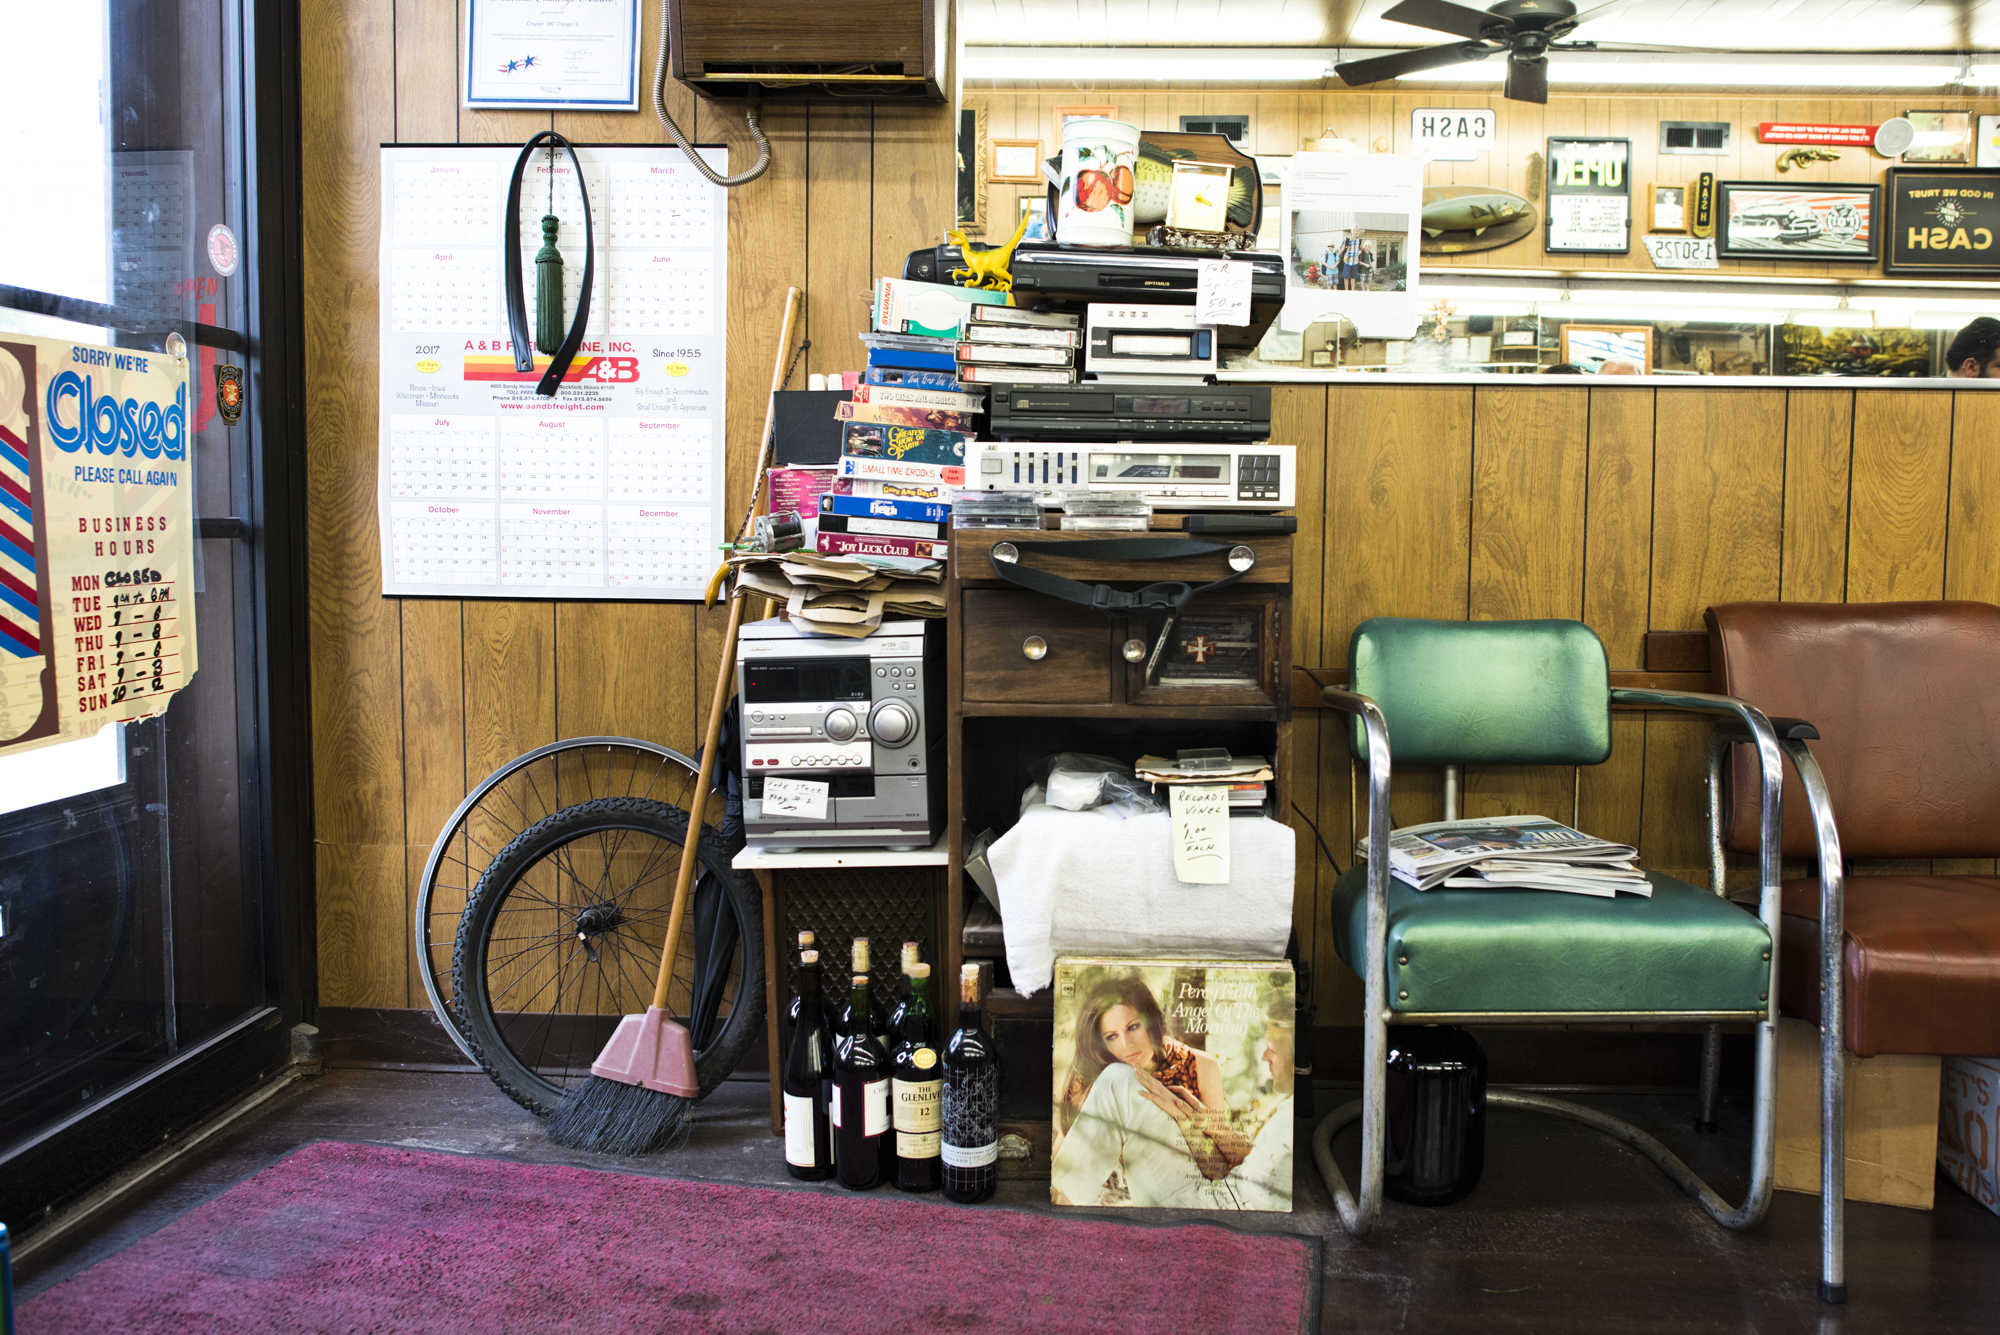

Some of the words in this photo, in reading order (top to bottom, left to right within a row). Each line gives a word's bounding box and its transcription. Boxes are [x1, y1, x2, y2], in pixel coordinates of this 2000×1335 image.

[430, 166, 461, 176] January
[650, 166, 675, 175] March
[434, 252, 453, 262] April
[651, 254, 671, 263] June
[881, 282, 892, 326] SYLVANIA
[415, 345, 440, 355] 2017
[652, 348, 675, 358] Since
[676, 348, 702, 358] 1955
[464, 340, 475, 351] A
[478, 340, 487, 351] &
[492, 340, 502, 351] B
[608, 342, 635, 353] INC.
[72, 346, 112, 368] SORRY
[114, 353, 149, 373] WE'RE
[578, 356, 641, 384] A&B
[415, 399, 440, 407] Missouri
[500, 402, 605, 412] www.aandbfreight.com
[46, 370, 187, 462] Closed
[434, 418, 451, 428] July
[538, 420, 566, 429] August
[638, 421, 681, 431] September
[888, 426, 926, 442] GREATEST
[915, 432, 925, 441] ON
[74, 465, 115, 484] PLEASE
[118, 468, 144, 485] CALL
[145, 470, 178, 487] AGAIN
[862, 464, 886, 474] SMALL
[905, 467, 936, 478] CROOKS
[882, 485, 900, 497] GUYS
[916, 487, 938, 499] DOLLS
[427, 505, 460, 515] October
[532, 507, 571, 517] November
[639, 508, 679, 518] December
[78, 516, 167, 534] BUSINESS
[94, 538, 155, 557] HOURS
[839, 541, 858, 553] JOY
[858, 542, 884, 555] LUCK
[883, 543, 910, 556] CLUB
[71, 575, 100, 592] MON
[104, 567, 162, 587] CLOSED
[72, 595, 102, 613] TUE
[74, 615, 102, 633] WED
[113, 610, 122, 627] 9
[153, 604, 162, 621] 6
[75, 634, 103, 653] THU
[115, 630, 123, 649] 9
[152, 623, 161, 640] 8
[77, 654, 105, 673] FRI
[116, 650, 124, 667] 9
[153, 640, 162, 658] 6
[77, 672, 107, 692] SAT
[117, 667, 125, 685] 9
[152, 658, 163, 677] 3
[79, 693, 108, 713] SUN
[111, 685, 127, 705] 10
[152, 677, 164, 692] 2
[1177, 982, 1220, 1002] Percy
[1219, 983, 1259, 1001] Faith
[1170, 1001, 1214, 1021] Angel
[1214, 1002, 1236, 1023] Of
[1235, 1002, 1261, 1019] The
[1184, 1017, 1249, 1038] Morning
[901, 1090, 942, 1103] GLENLIVE
[918, 1085, 932, 1093] THE
[920, 1107, 930, 1116] 12
[1943, 1154, 1996, 1206] THIS
